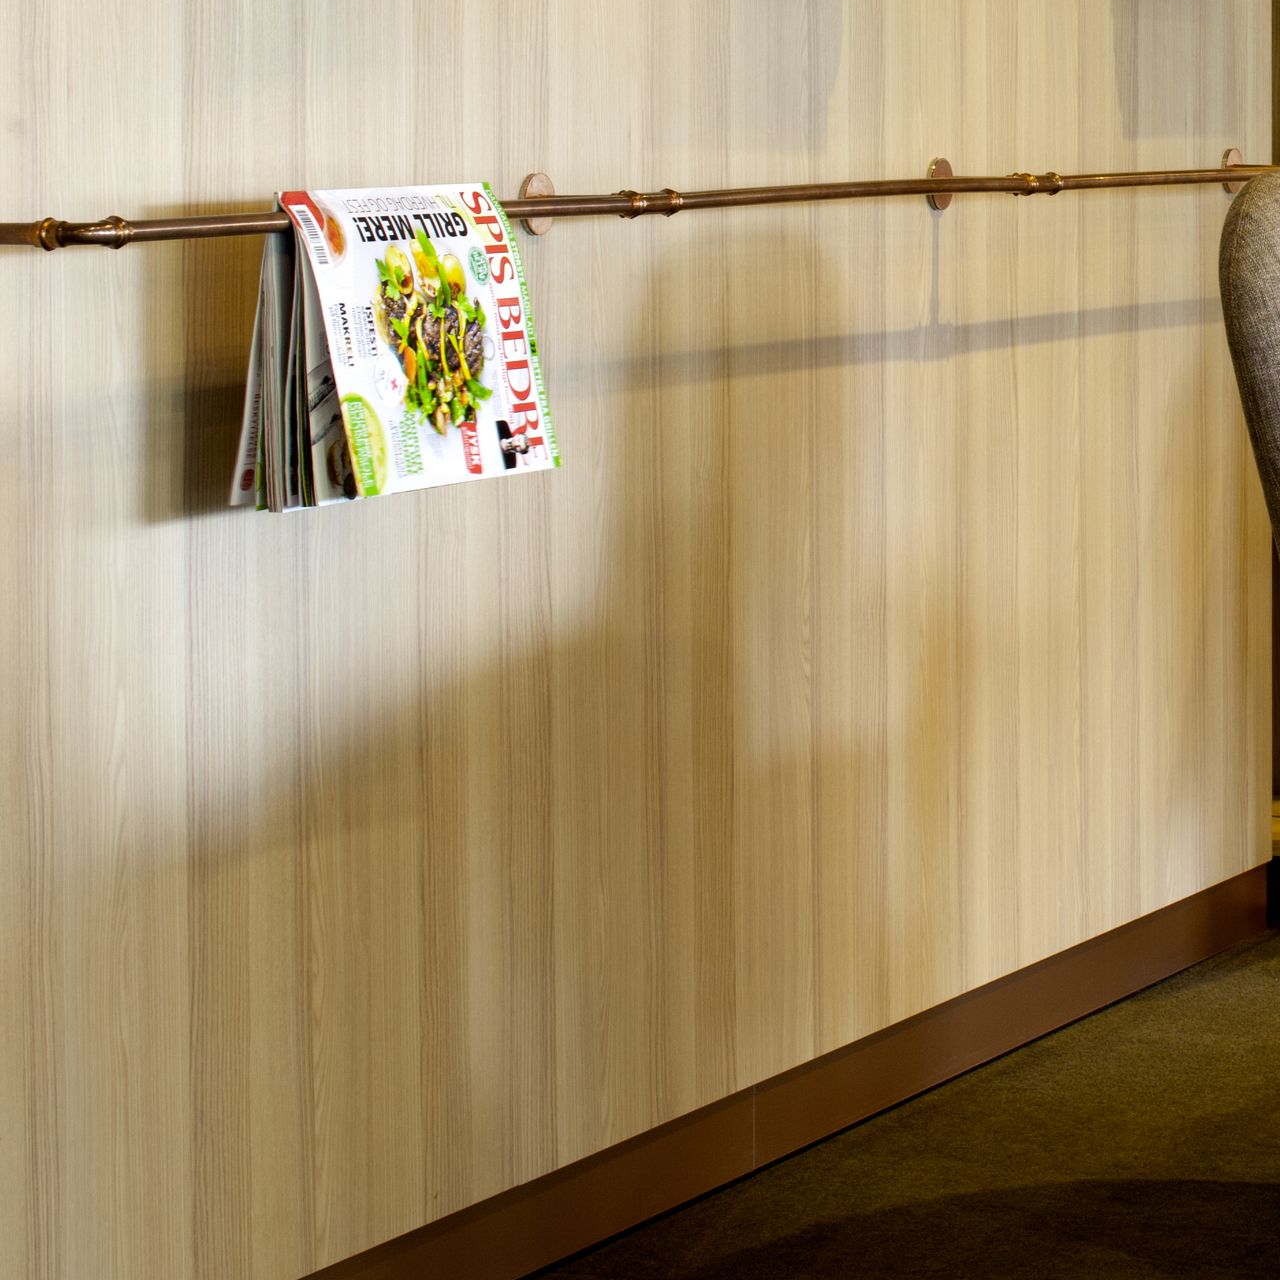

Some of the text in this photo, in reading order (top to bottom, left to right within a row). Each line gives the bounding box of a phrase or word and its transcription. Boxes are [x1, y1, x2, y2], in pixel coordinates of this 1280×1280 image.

[385, 195, 437, 212] HVERDAG
[484, 189, 514, 240] DANMARKS
[352, 211, 468, 242] GRILL MERE!
[508, 241, 526, 282] STØRSTE
[338, 302, 354, 366] MAKREL!
[364, 306, 378, 356] ISFEST!
[459, 191, 516, 284] SPIS
[495, 297, 549, 466] BEDRE
[531, 356, 545, 393] RETTER
[538, 394, 550, 414] FRA
[465, 430, 482, 465] JYSK
[542, 415, 559, 458] GRILLEN
